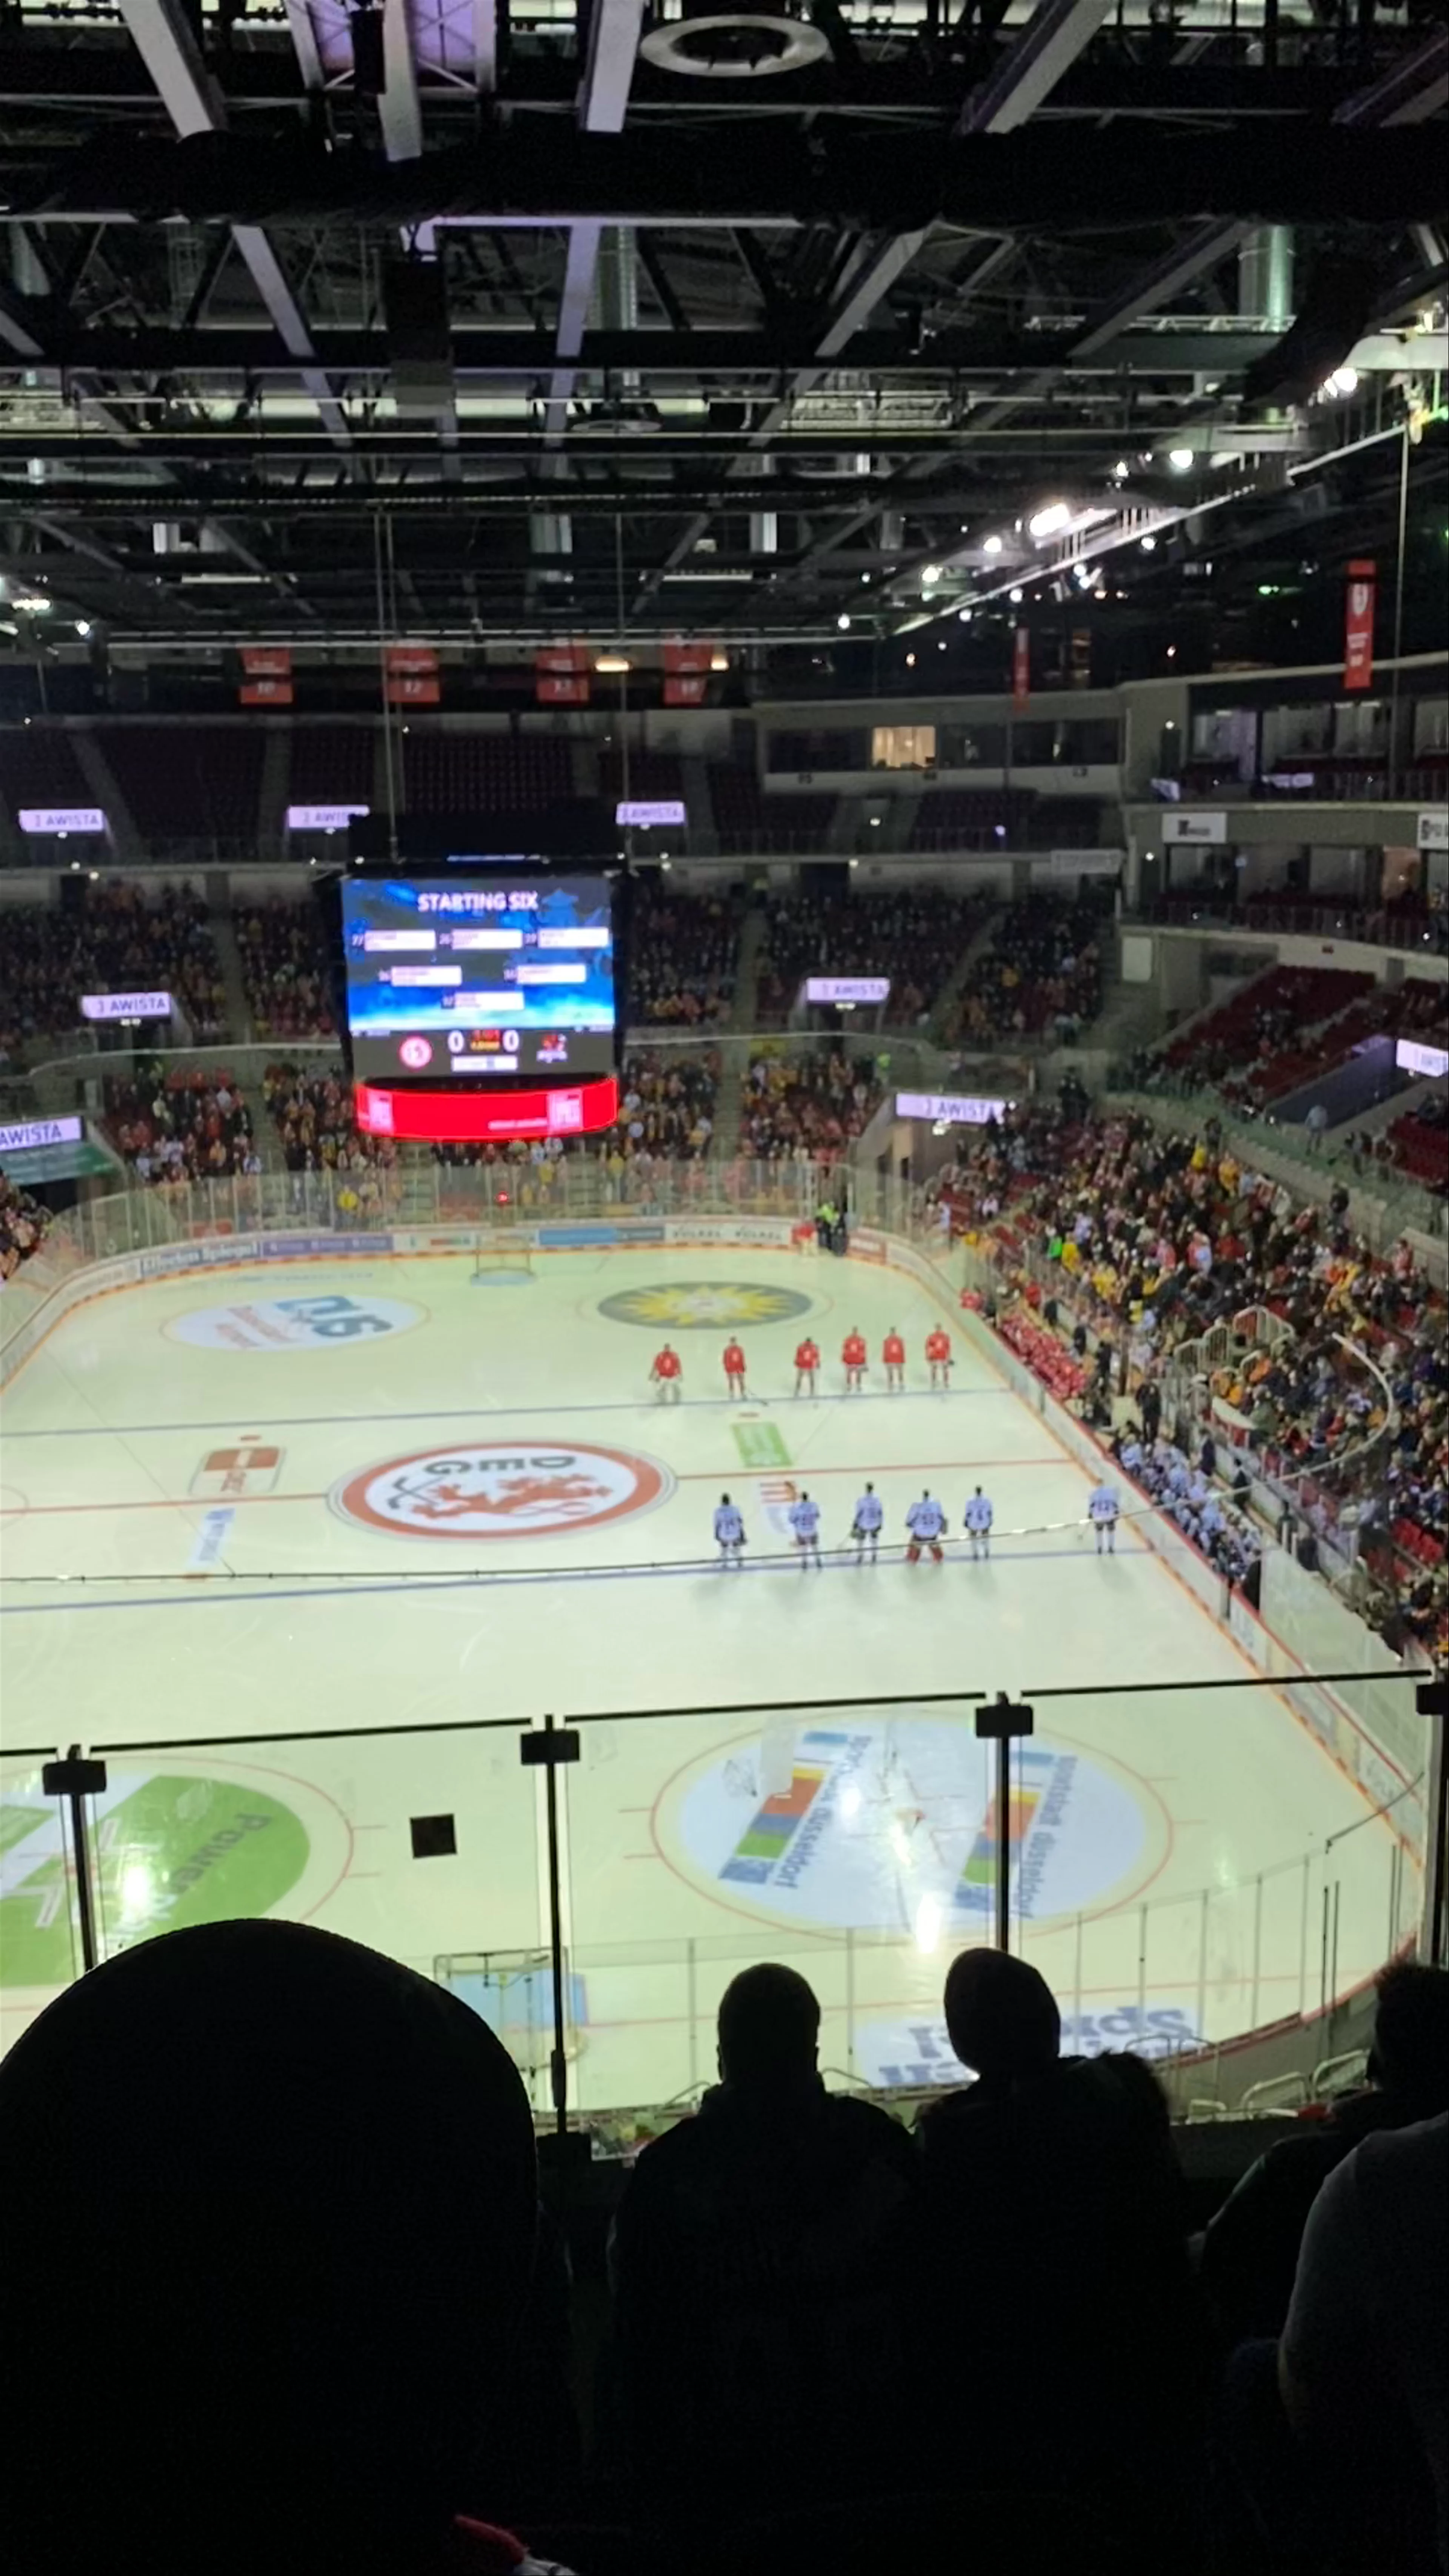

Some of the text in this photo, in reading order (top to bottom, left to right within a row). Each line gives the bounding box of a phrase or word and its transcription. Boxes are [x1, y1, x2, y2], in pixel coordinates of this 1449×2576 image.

[46, 815, 99, 826] AWISTA
[418, 890, 538, 913] STARTING SIX
[110, 997, 165, 1012] AWISTA
[448, 1030, 464, 1053] 0
[503, 1030, 519, 1052] 0
[0, 1121, 62, 1145] AWISTA
[422, 1456, 576, 1475] DEG
